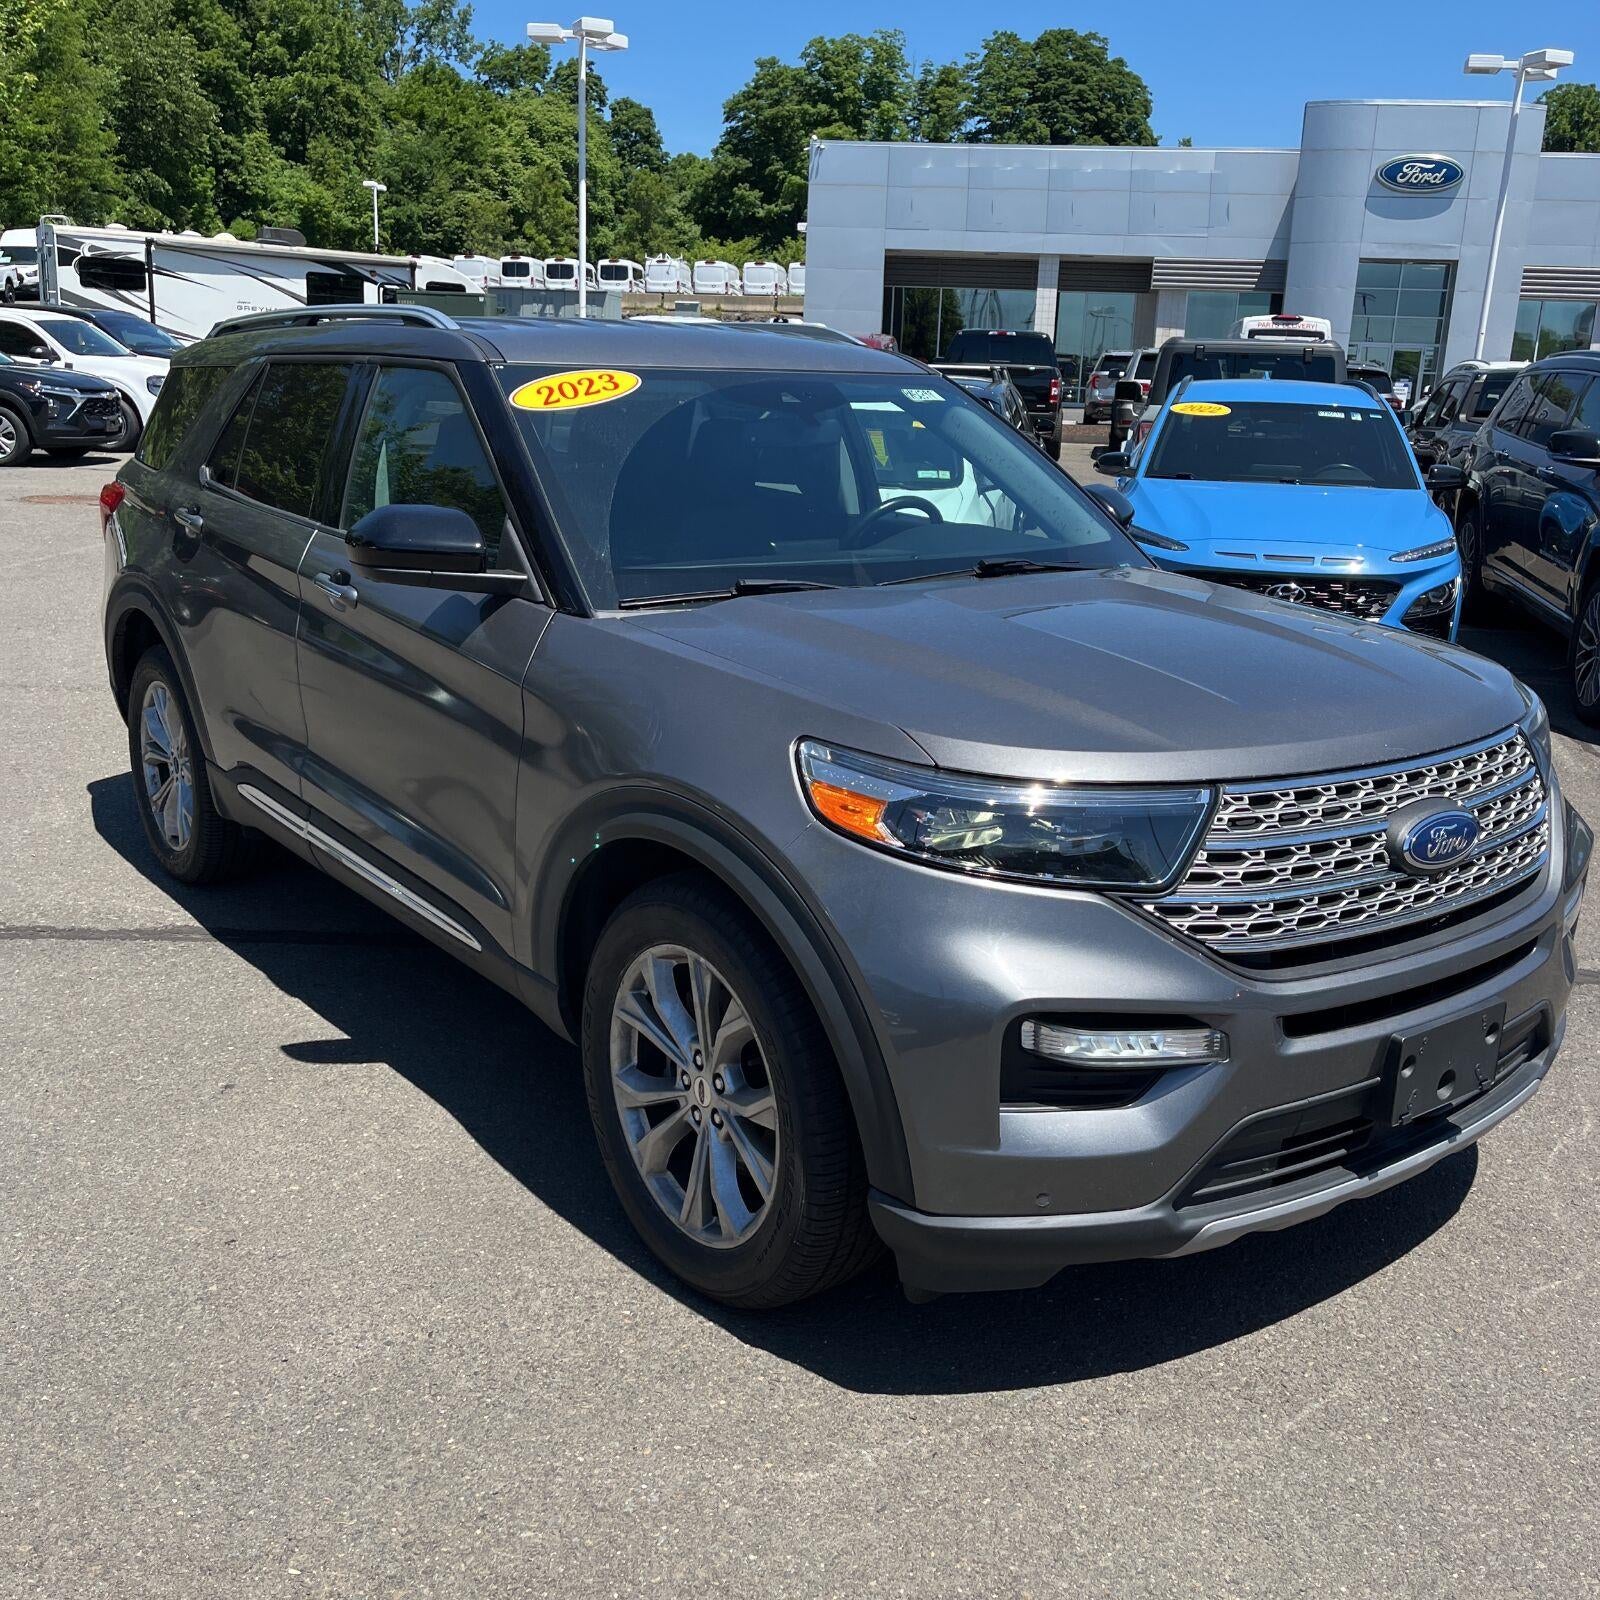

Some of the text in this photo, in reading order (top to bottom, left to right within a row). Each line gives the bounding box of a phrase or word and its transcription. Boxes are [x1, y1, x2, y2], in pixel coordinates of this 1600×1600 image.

[1397, 162, 1447, 184] Ford
[536, 373, 620, 406] 2023
[1427, 823, 1468, 858] Ford
